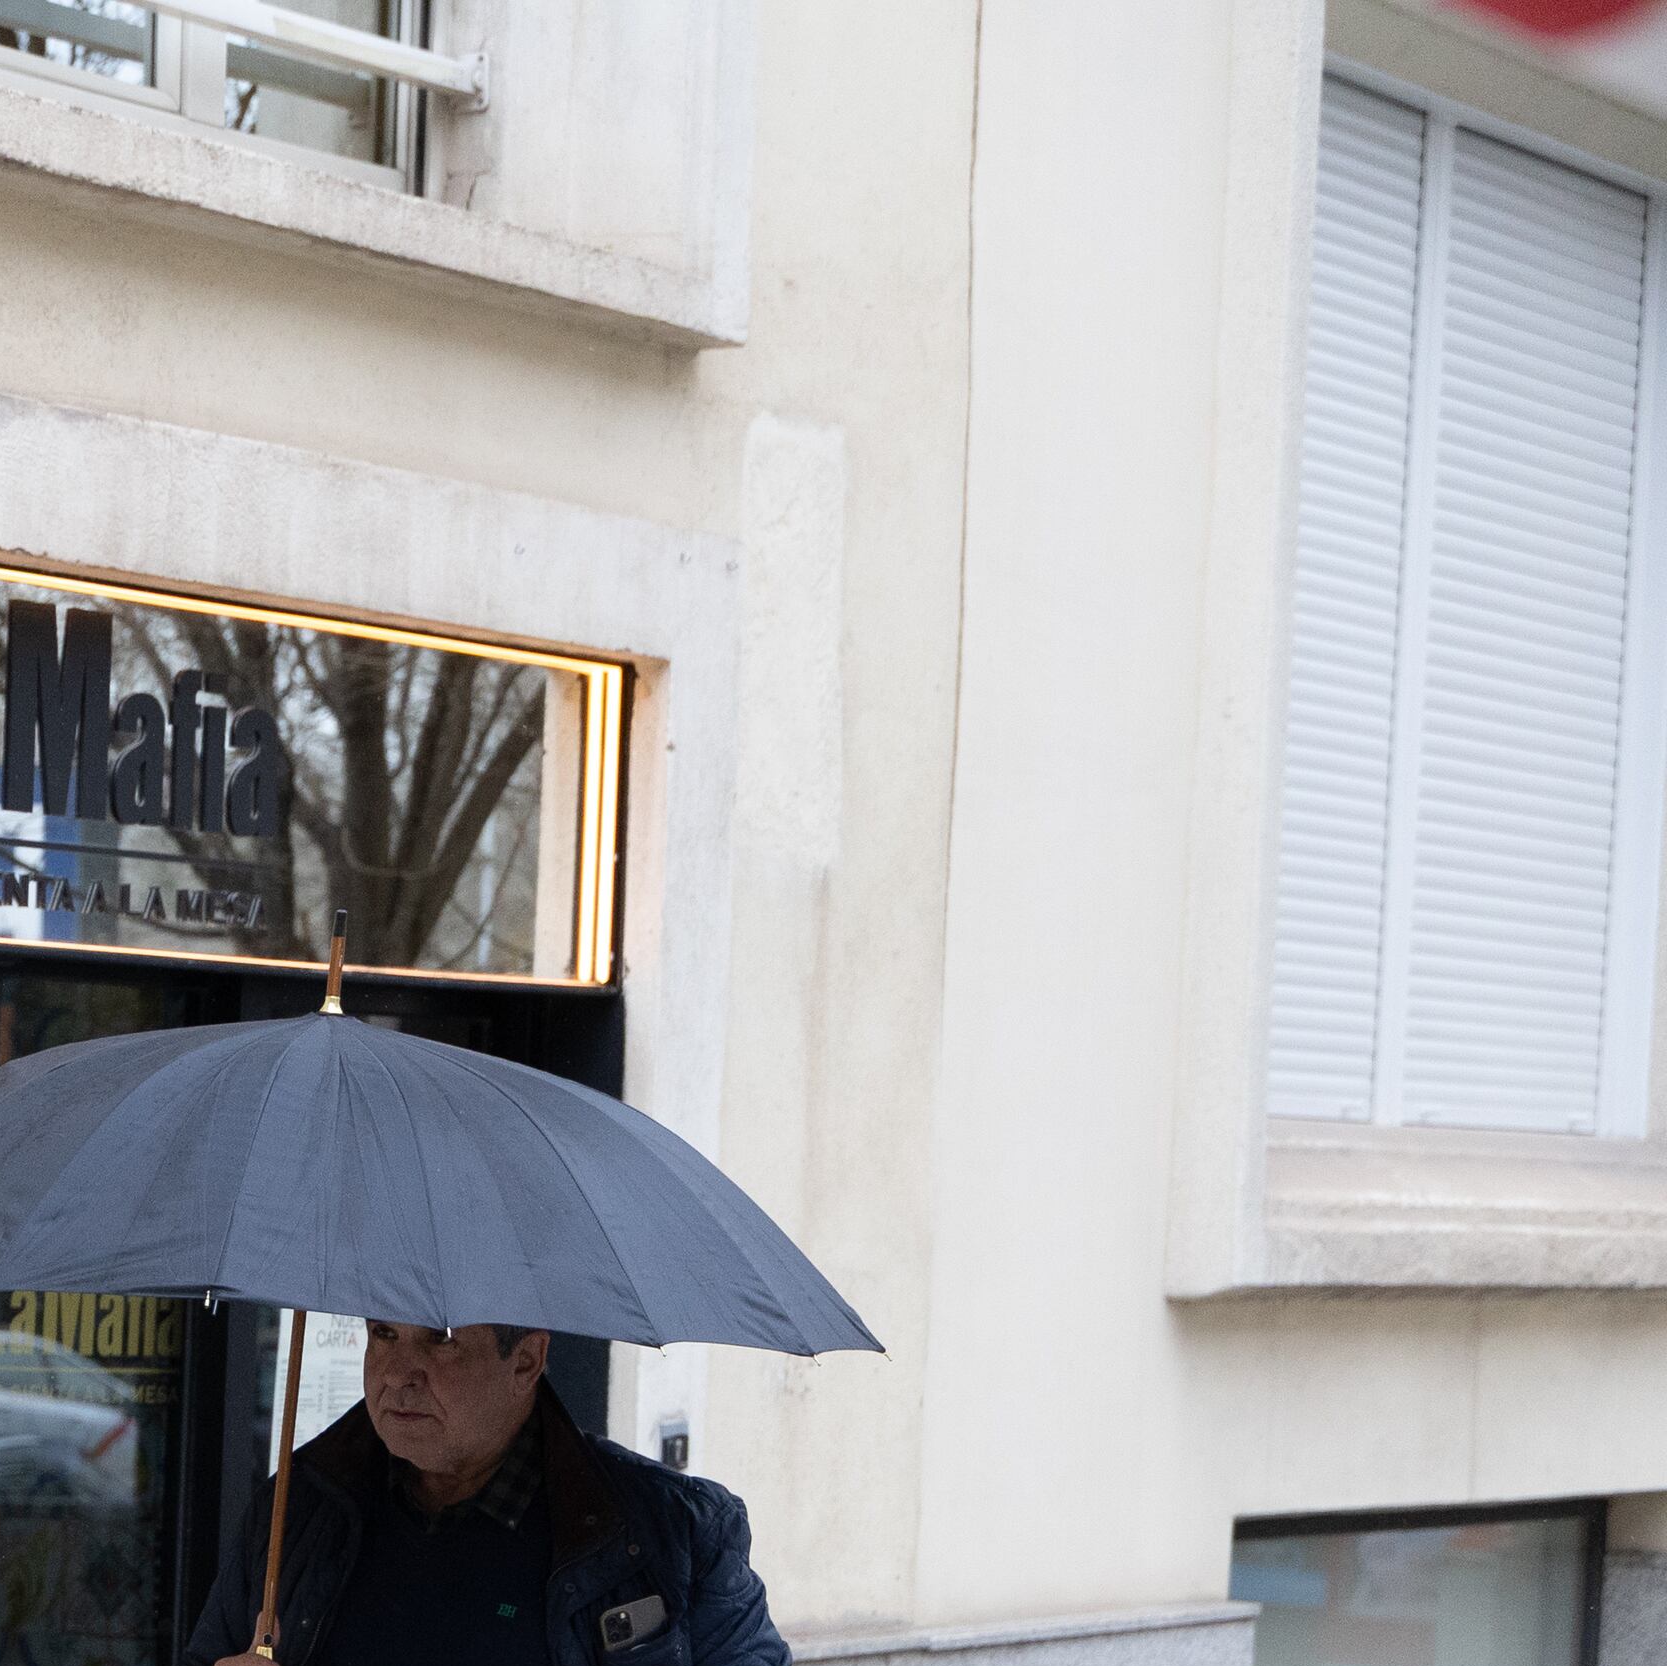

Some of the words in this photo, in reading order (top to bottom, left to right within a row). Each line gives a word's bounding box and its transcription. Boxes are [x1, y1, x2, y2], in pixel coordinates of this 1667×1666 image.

[80, 880, 106, 914] A
[119, 883, 168, 920] LA
[174, 888, 267, 930] MESA
[316, 1330, 358, 1348] CARTA
